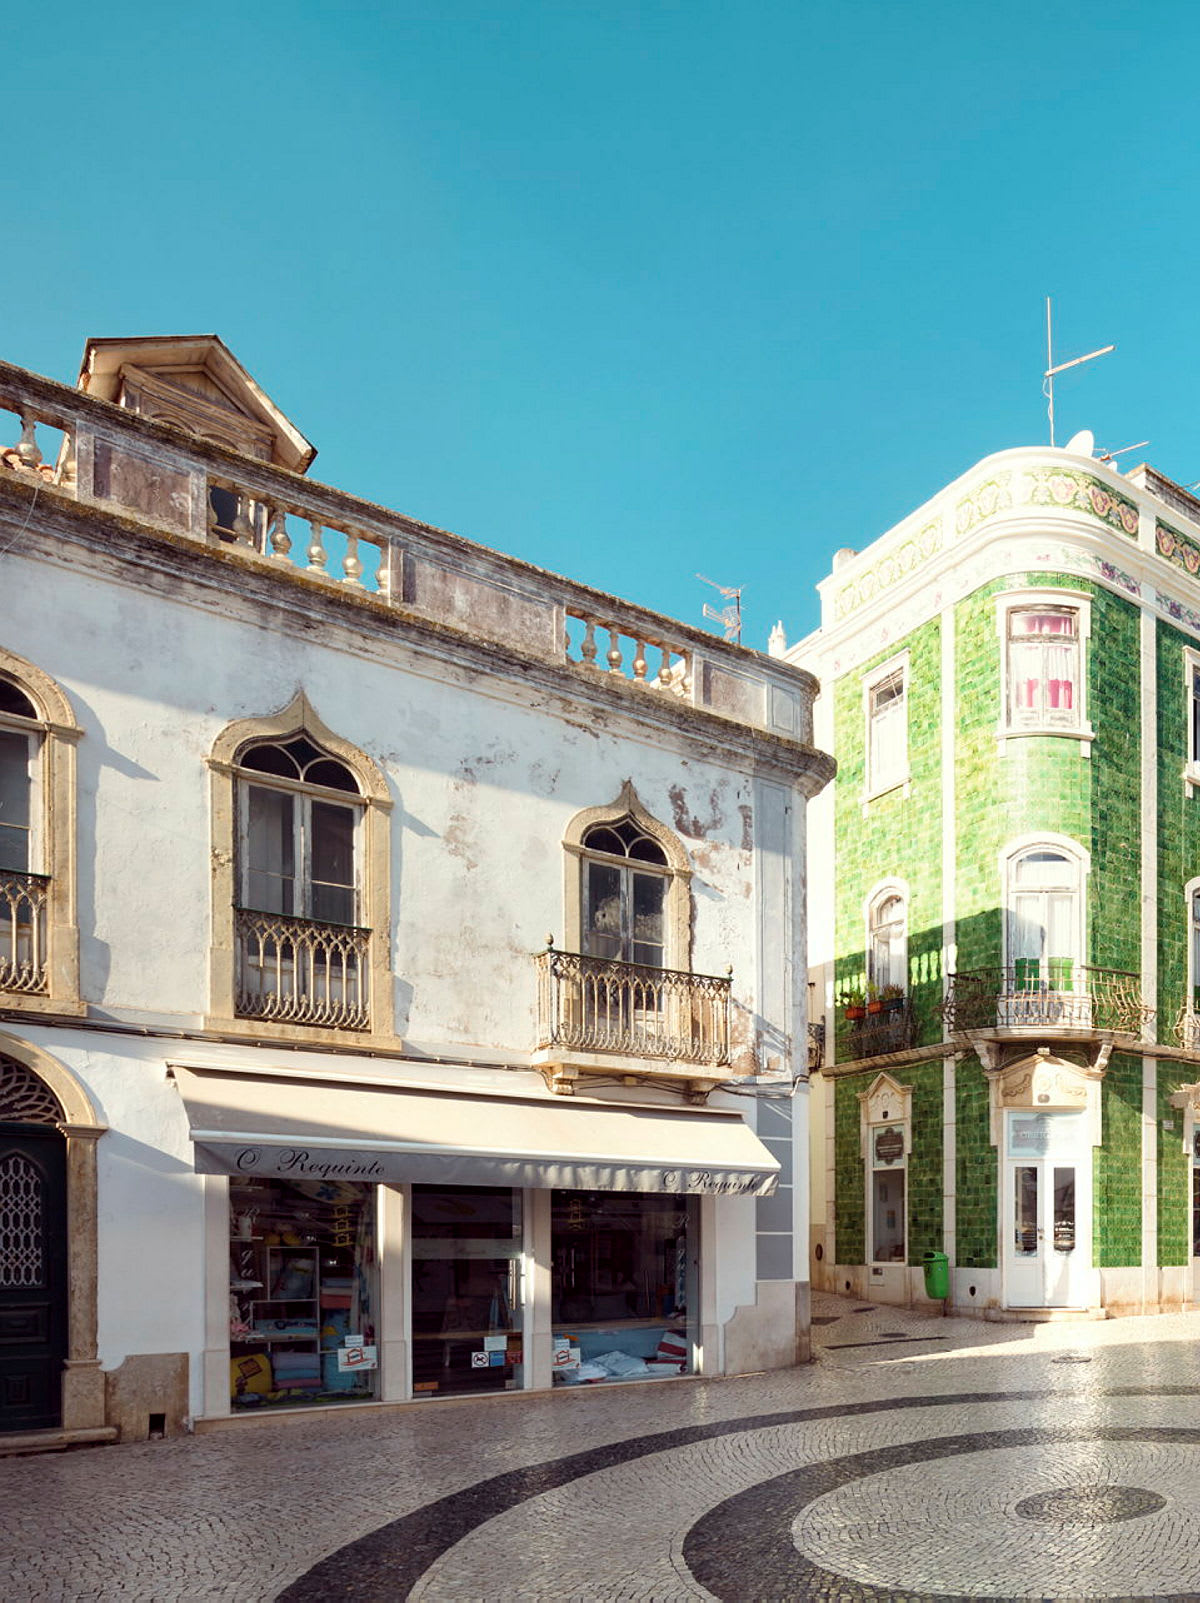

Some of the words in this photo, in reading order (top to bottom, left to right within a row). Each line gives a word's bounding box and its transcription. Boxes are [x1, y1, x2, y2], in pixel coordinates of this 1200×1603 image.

[236, 1148, 261, 1171] O
[276, 1148, 386, 1178] Requinte
[663, 1170, 677, 1188] O
